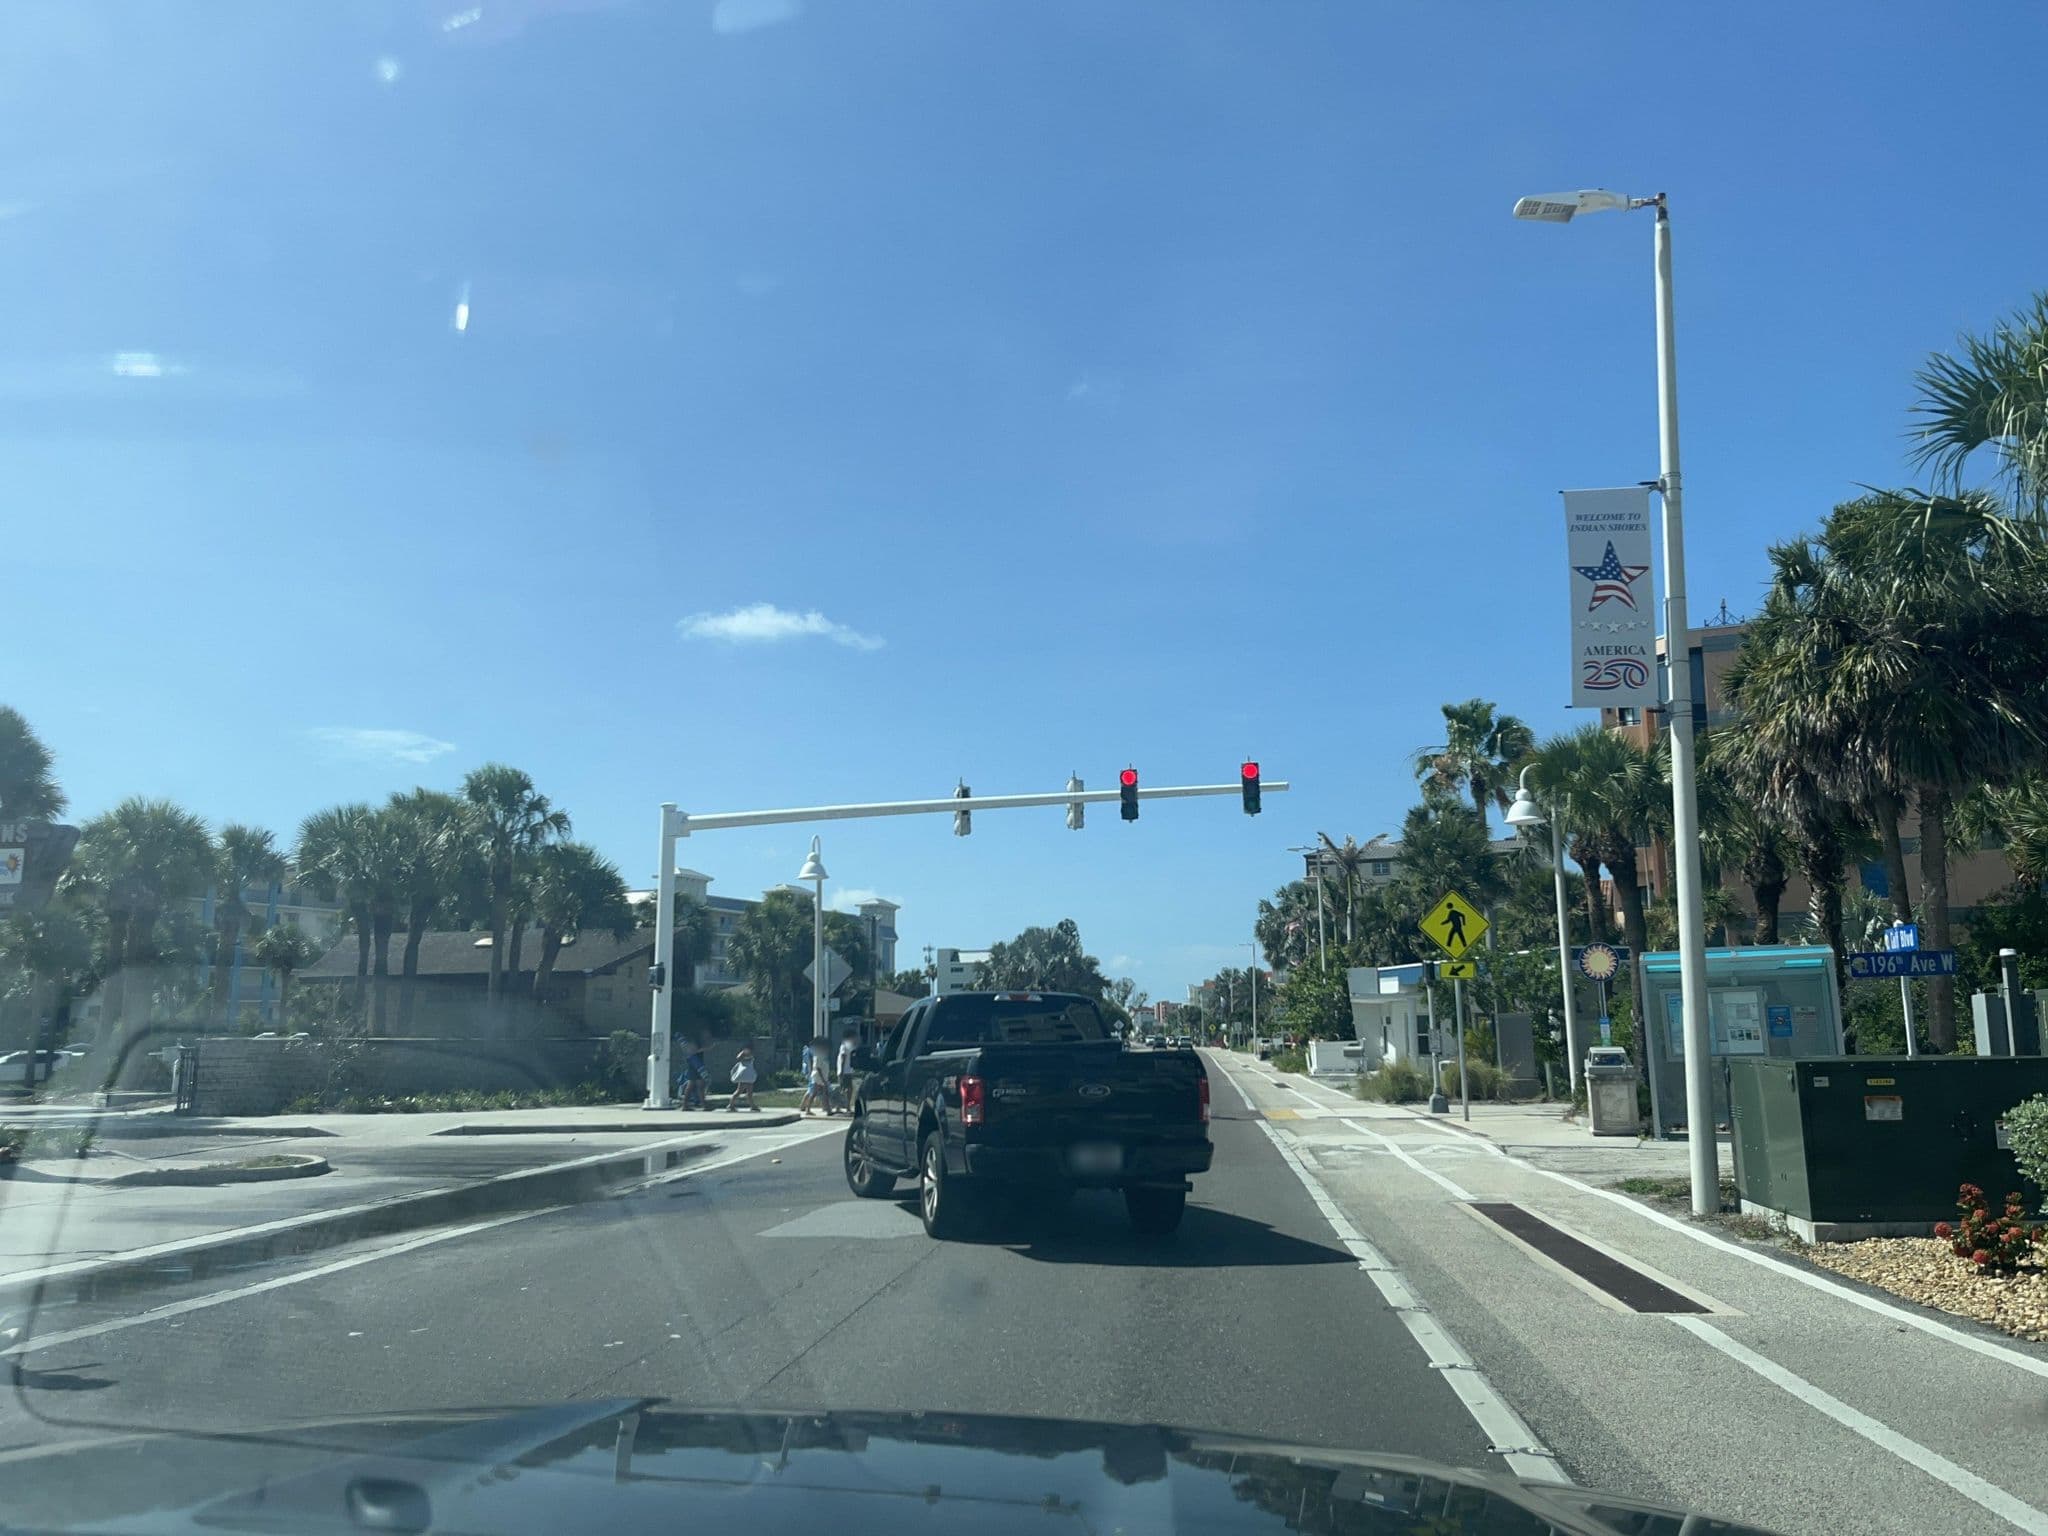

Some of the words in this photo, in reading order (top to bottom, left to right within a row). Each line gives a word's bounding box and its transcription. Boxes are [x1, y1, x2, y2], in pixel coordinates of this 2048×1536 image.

[1576, 512, 1626, 521] WELCOME
[1628, 512, 1641, 521] TO
[1570, 523, 1606, 532] INDIAN
[1608, 523, 1647, 531] SHORES
[1584, 645, 1647, 656] AMERICA
[1584, 658, 1649, 691] 250
[1900, 928, 1914, 948] Blvd
[1870, 956, 1904, 974] 196th
[1911, 955, 1937, 972] Ave
[1941, 953, 1953, 972] W
